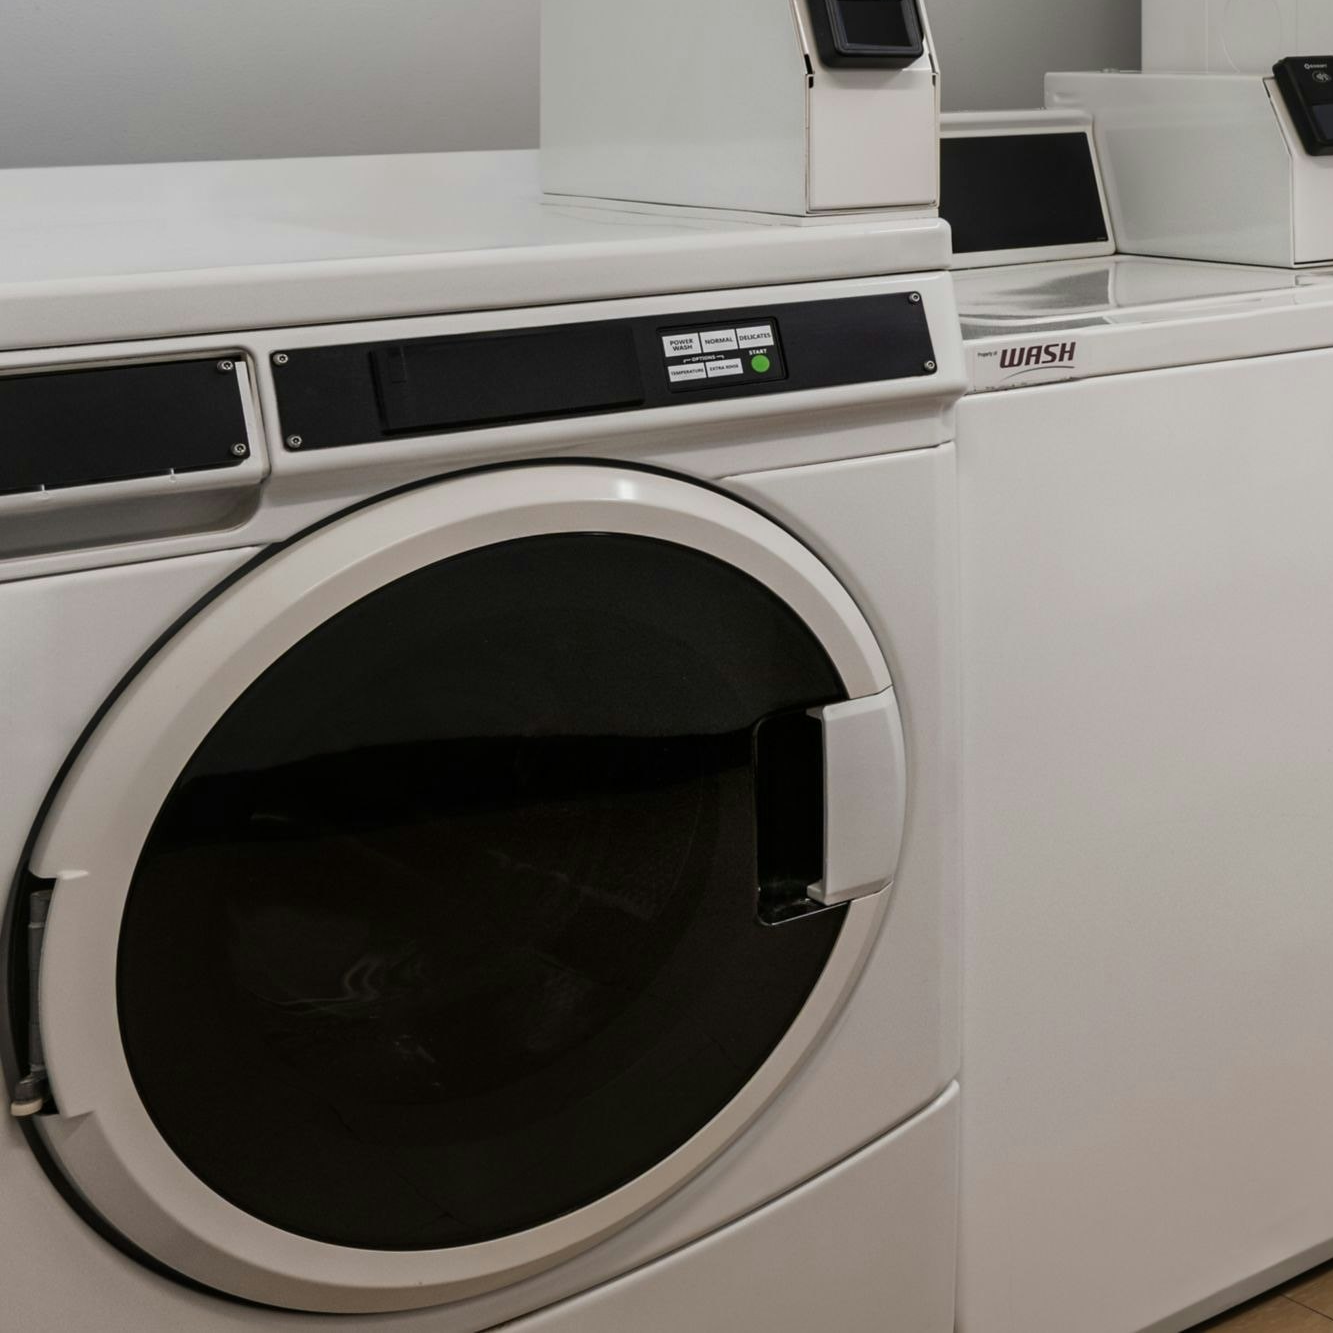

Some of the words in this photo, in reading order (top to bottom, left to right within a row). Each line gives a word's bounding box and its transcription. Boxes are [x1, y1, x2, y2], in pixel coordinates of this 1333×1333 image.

[705, 337, 733, 345] NORMAL
[739, 333, 771, 341] DELICATES
[1000, 342, 1076, 368] WASH
[671, 368, 704, 376] TEMPERATURE
